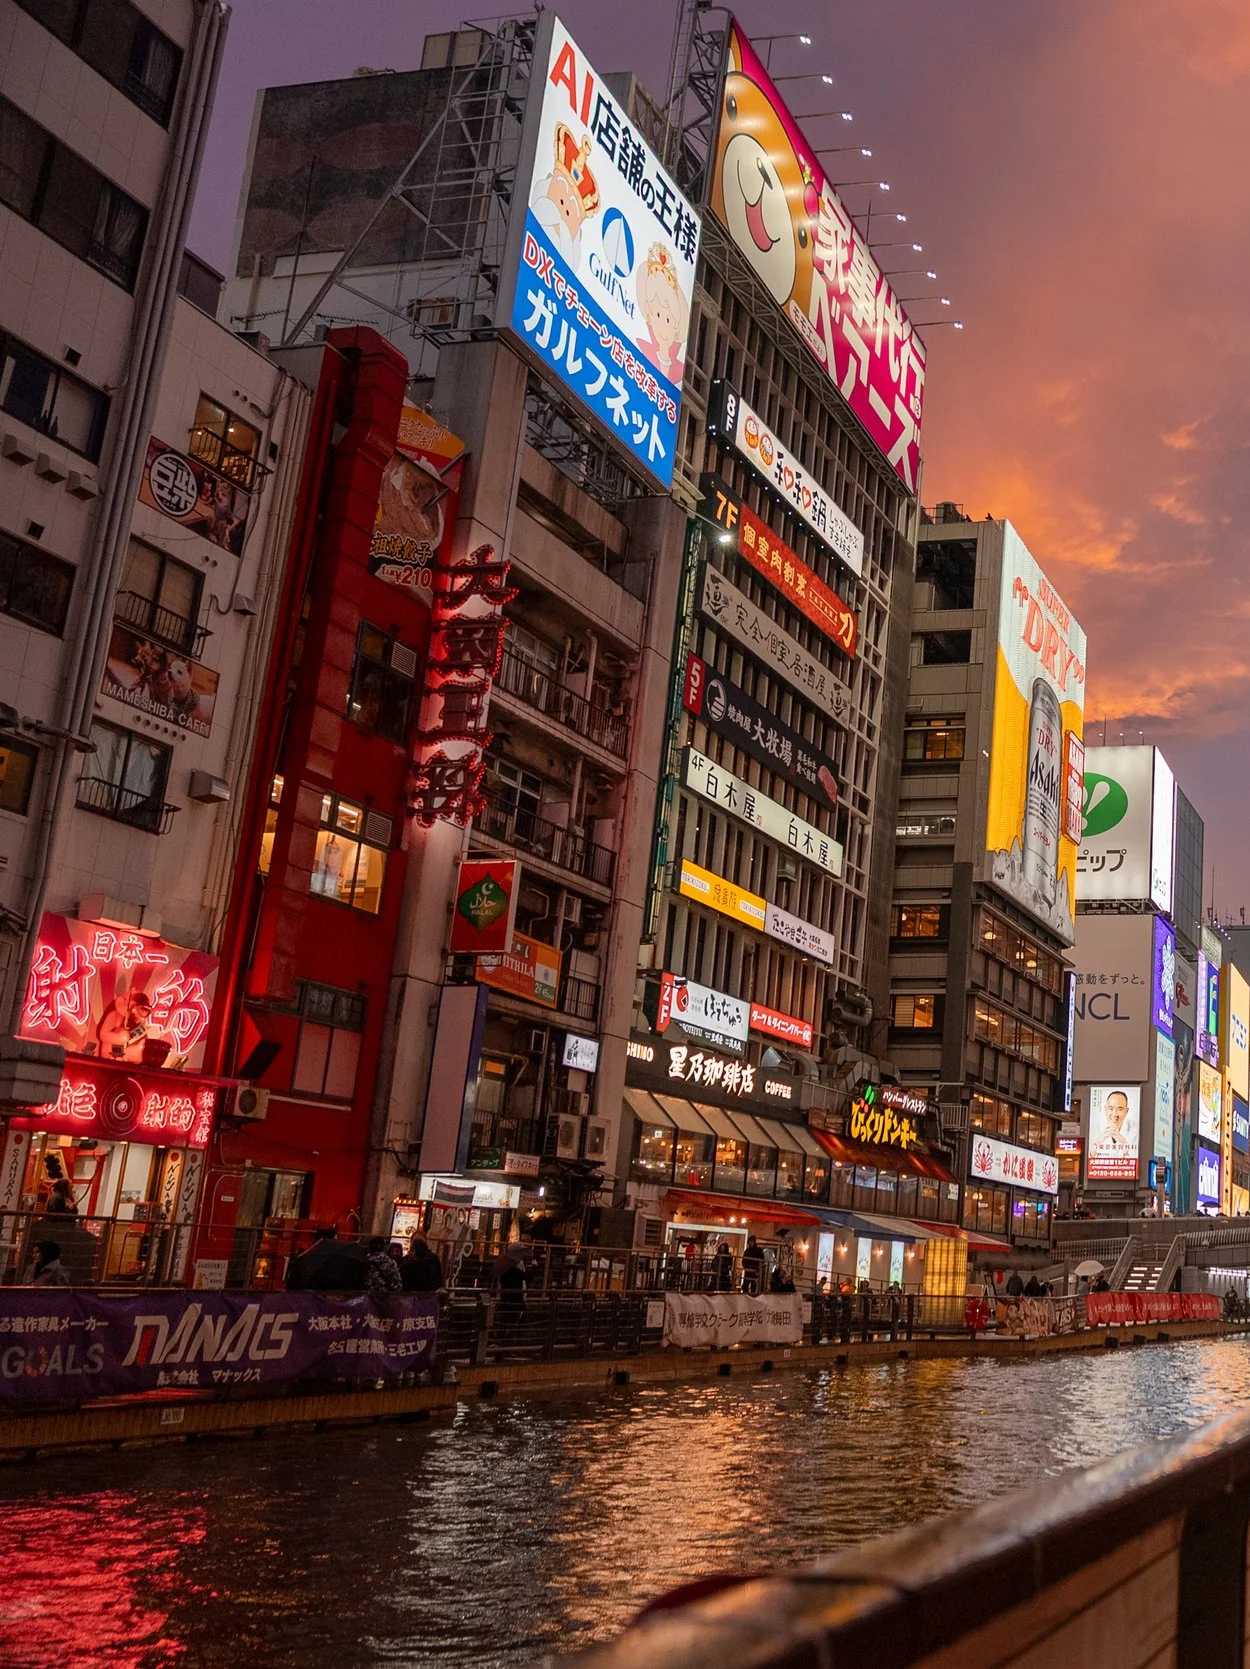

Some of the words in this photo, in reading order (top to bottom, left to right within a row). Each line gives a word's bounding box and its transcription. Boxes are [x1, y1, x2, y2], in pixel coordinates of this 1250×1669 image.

[550, 41, 698, 264] AI店舗の王様
[815, 178, 926, 412] 家事代行
[523, 233, 677, 424] DXでチェーン店を改革する
[523, 288, 666, 462] ガルフネット
[809, 266, 921, 497] ベアーズ
[715, 490, 738, 529] 7F
[743, 522, 808, 599] 個室肉割烹
[838, 612, 854, 648] 刀
[1039, 579, 1070, 634] SUPER
[735, 602, 827, 701] 完全個室居酒屋
[106, 682, 175, 722] MAMESHIBA
[178, 713, 210, 736] CAFE
[689, 661, 701, 705] 5F
[727, 703, 751, 733] 焼肉屋
[751, 717, 794, 767] 大牧場
[691, 754, 705, 771] 4F
[1030, 748, 1060, 804] Asahi
[706, 765, 755, 824] 白木屋
[787, 817, 829, 867] 白木屋
[1076, 847, 1127, 873] ピップ
[93, 931, 170, 968] 日本一
[660, 983, 670, 1024] 2F
[668, 1045, 756, 1097] 星乃珈琲店
[764, 1079, 792, 1099] COFFEE
[851, 1101, 917, 1149] びっくりドンキー
[3, 1148, 19, 1205] SAMURAI
[165, 1163, 180, 1199] NINJA
[211, 1367, 261, 1383] マナックス
